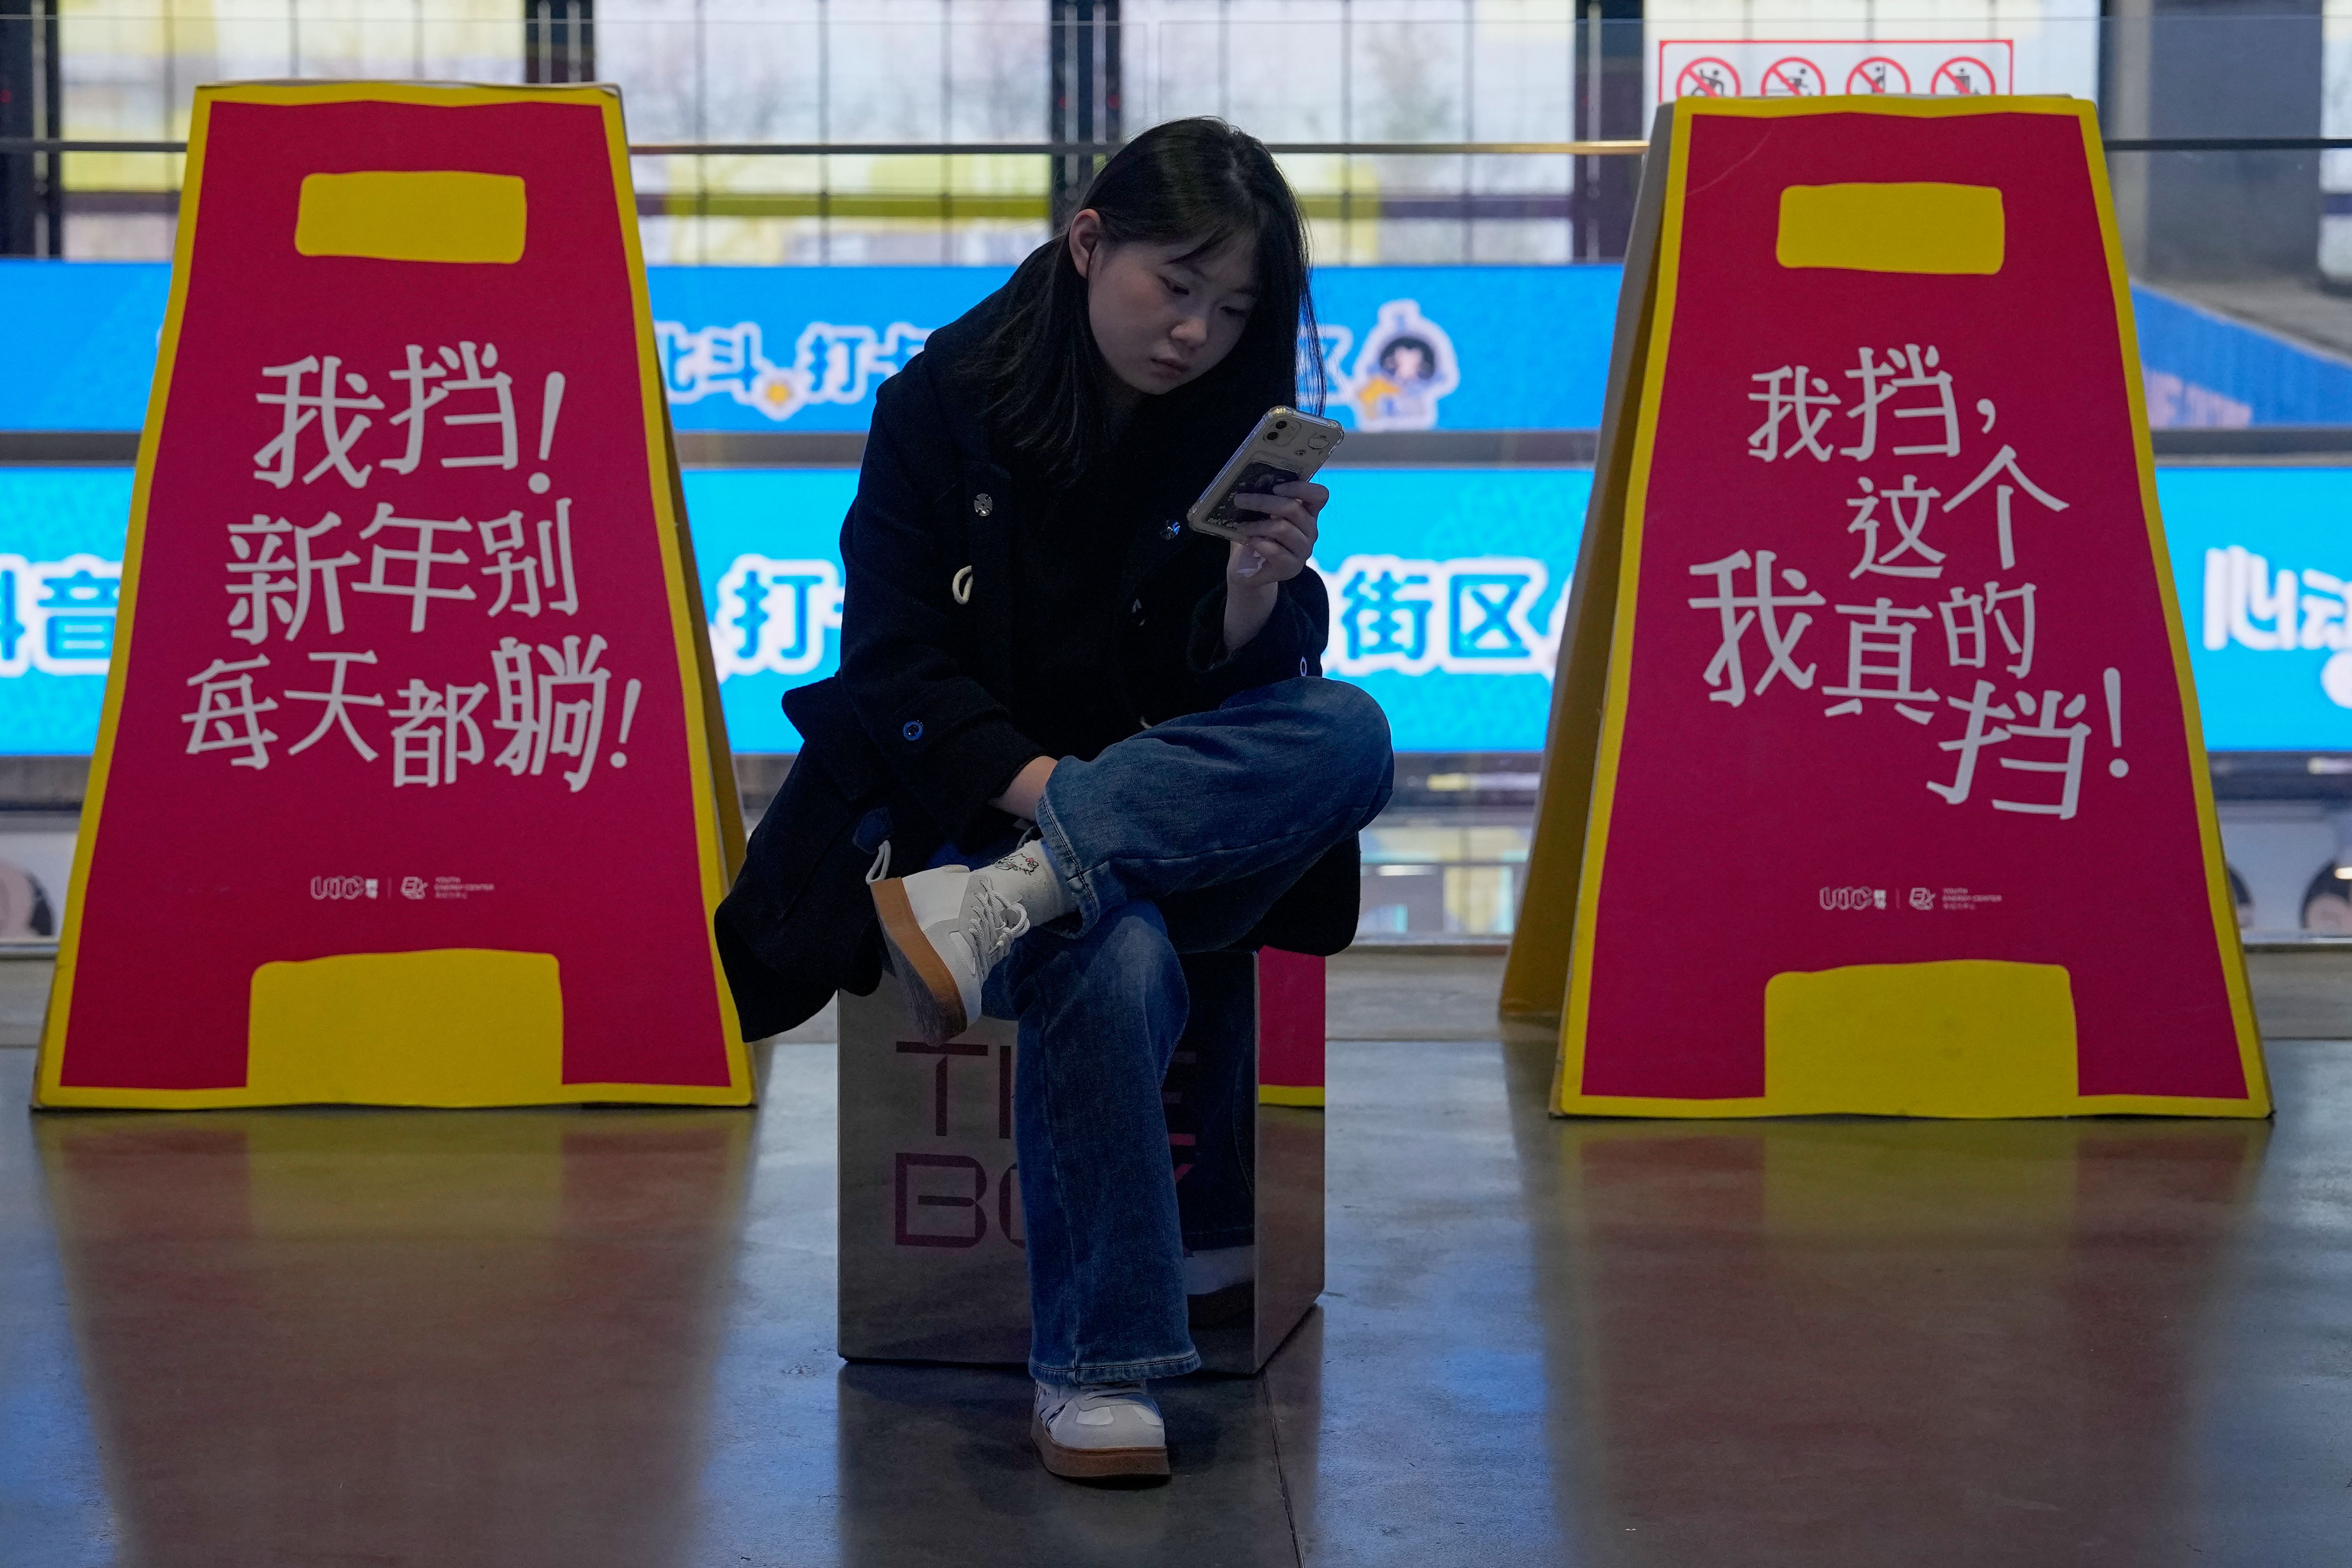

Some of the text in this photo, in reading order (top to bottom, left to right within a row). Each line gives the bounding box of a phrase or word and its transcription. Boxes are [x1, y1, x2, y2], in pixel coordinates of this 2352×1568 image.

[253, 341, 565, 494] 我挡！
[1748, 344, 1995, 462] 我挡，
[225, 498, 578, 644] 新年别
[1846, 445, 2069, 579] 这个
[181, 634, 641, 792] 每天都躺！
[1688, 549, 2036, 725] 我真的
[1926, 667, 2129, 820] 挡！
